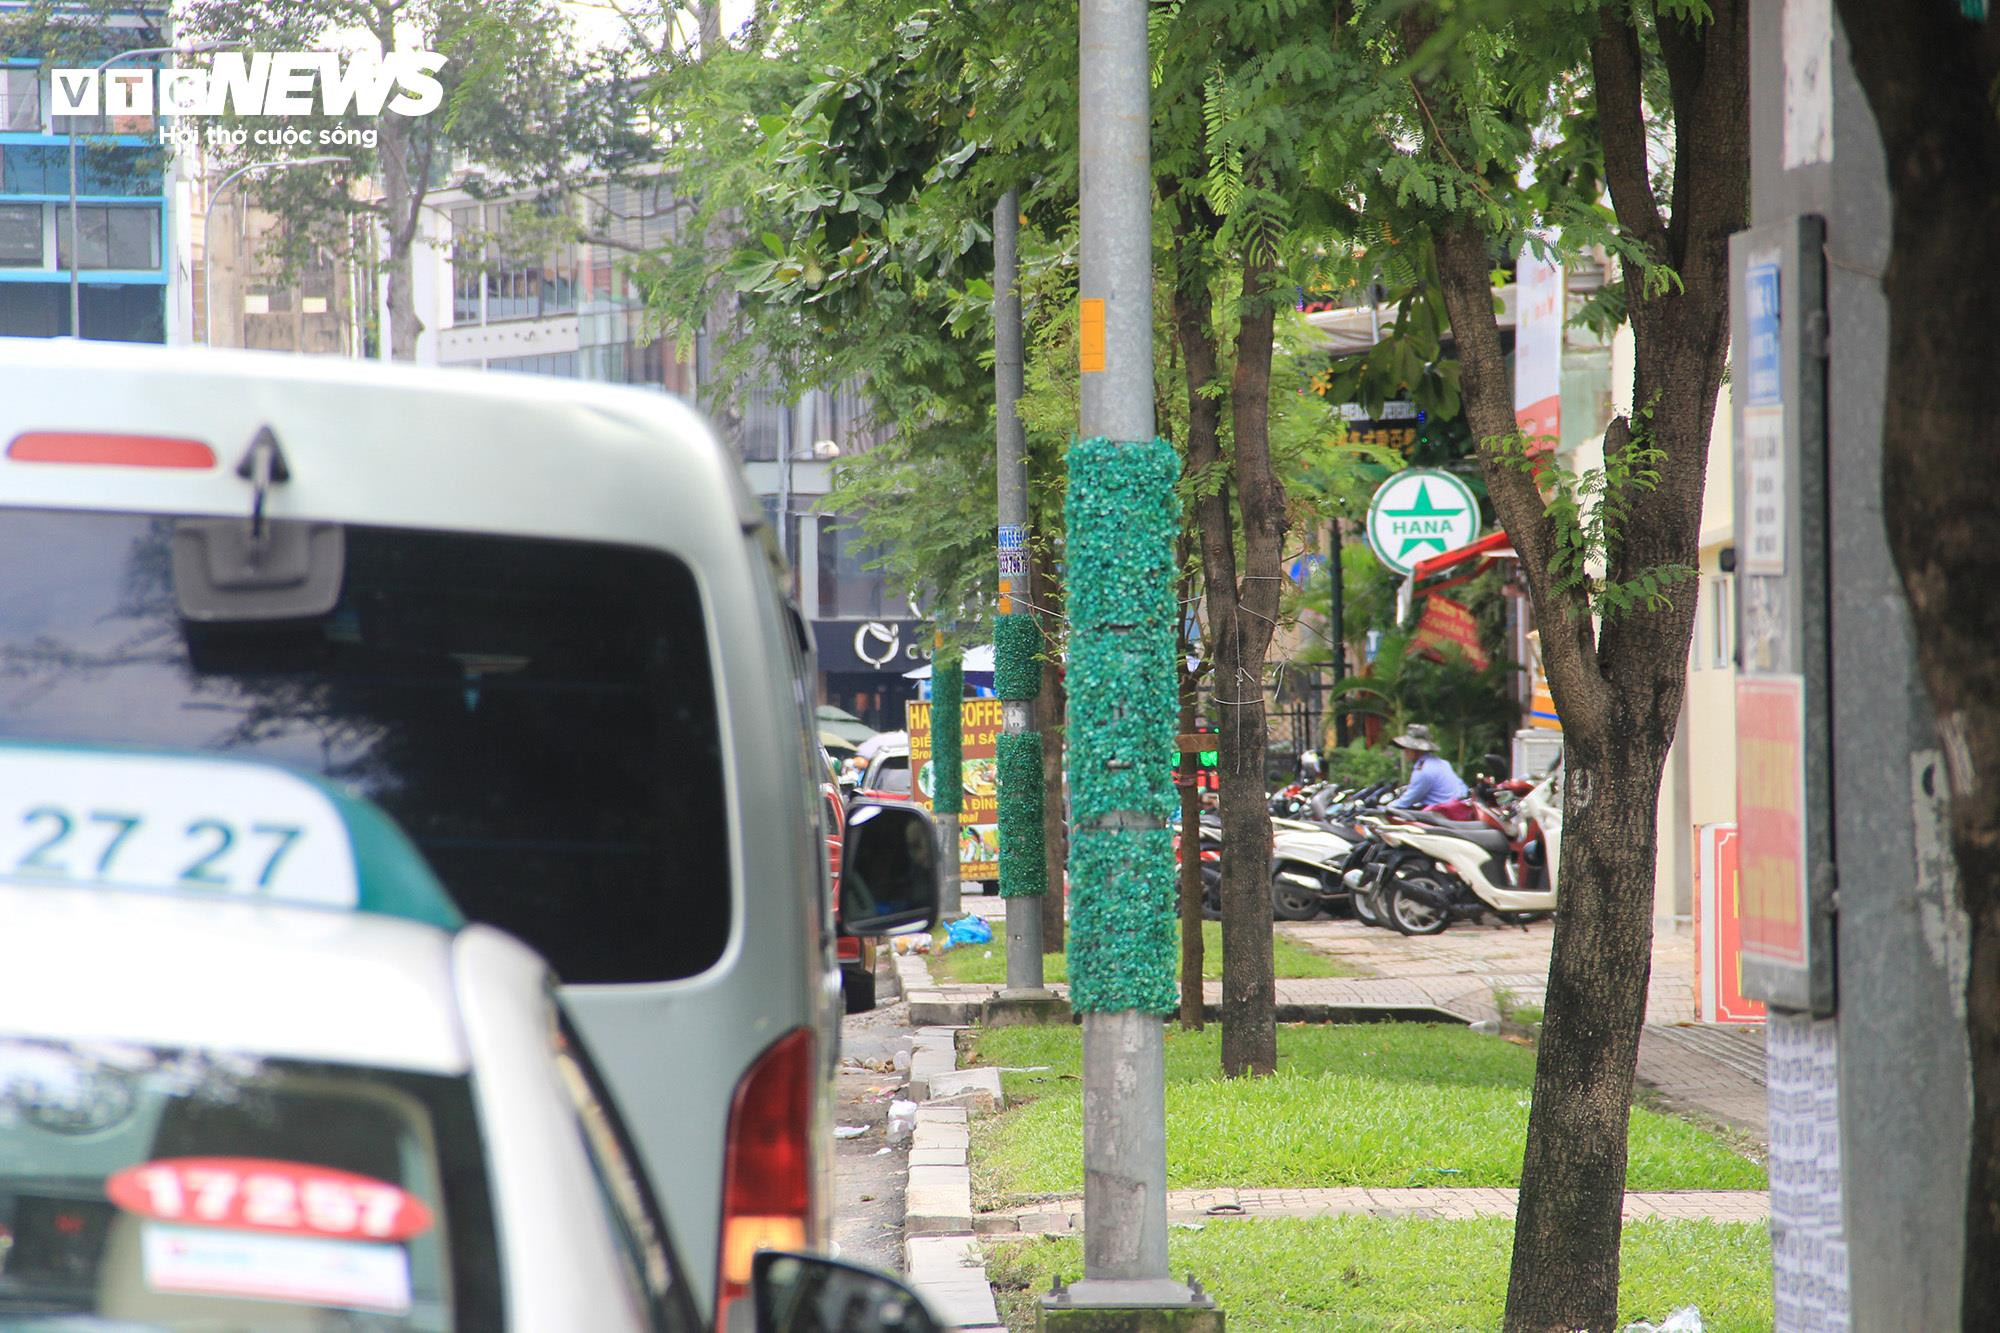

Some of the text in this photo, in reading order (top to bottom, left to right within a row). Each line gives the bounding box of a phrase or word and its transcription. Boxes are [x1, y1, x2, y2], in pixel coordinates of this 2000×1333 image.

[1393, 519, 1454, 535] HANA
[910, 704, 933, 730] HA
[978, 730, 996, 745] SÁ
[16, 805, 307, 888] 27 27
[136, 1165, 403, 1238] 17257
